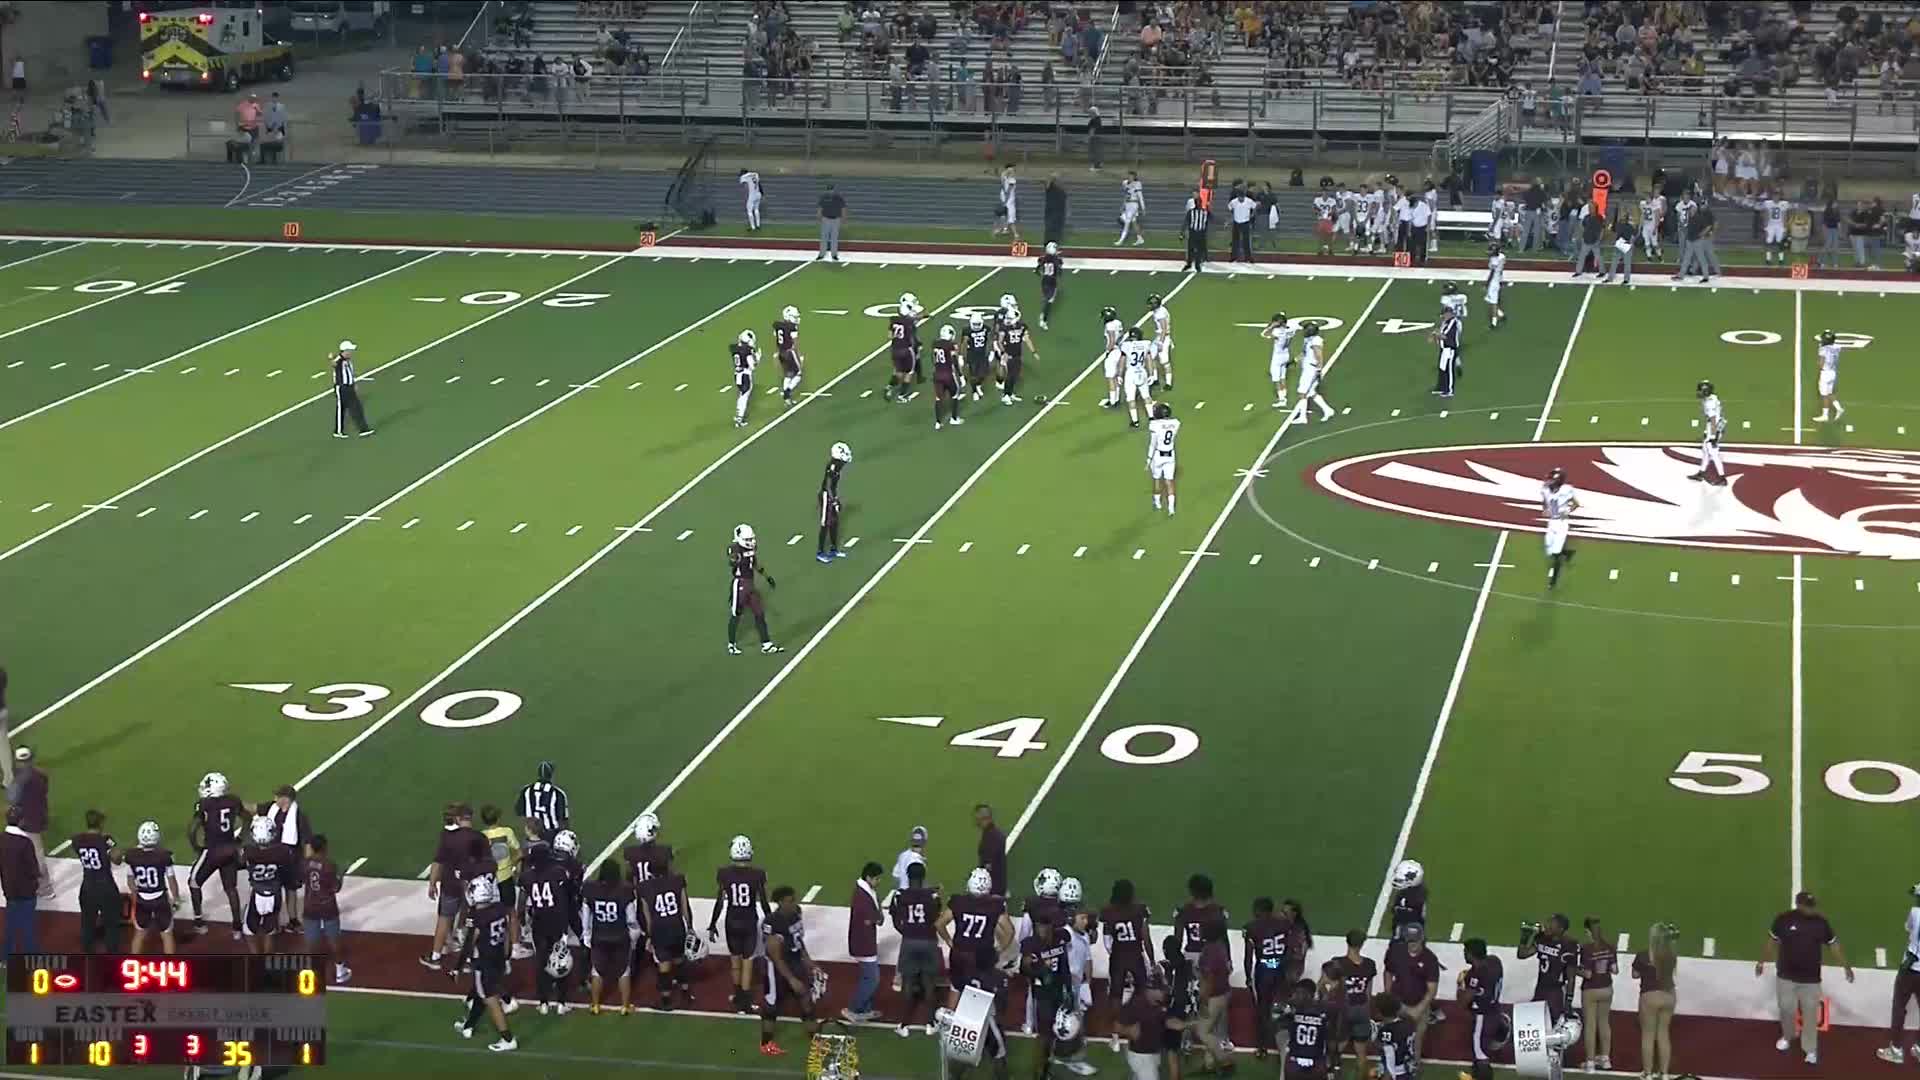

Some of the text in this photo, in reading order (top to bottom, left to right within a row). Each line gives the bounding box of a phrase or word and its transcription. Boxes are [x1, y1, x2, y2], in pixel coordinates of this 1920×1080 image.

[285, 222, 299, 237] 10
[641, 232, 655, 246] 20
[1130, 351, 1145, 366] 34
[1163, 430, 1173, 446] 8
[219, 807, 231, 832] 5
[135, 866, 159, 888] 20
[252, 864, 278, 881] 22
[532, 881, 555, 907] 44
[654, 891, 680, 918] 48
[730, 883, 750, 906] 18
[593, 900, 619, 923] 58
[907, 903, 925, 924] 14
[962, 913, 987, 938] 77
[1115, 921, 1137, 942] 21
[1262, 934, 1286, 956] 25
[949, 1036, 975, 1051] FOGG
[951, 1025, 978, 1041] BIG
[1296, 1024, 1318, 1046] 60
[1518, 1029, 1540, 1039] BIG
